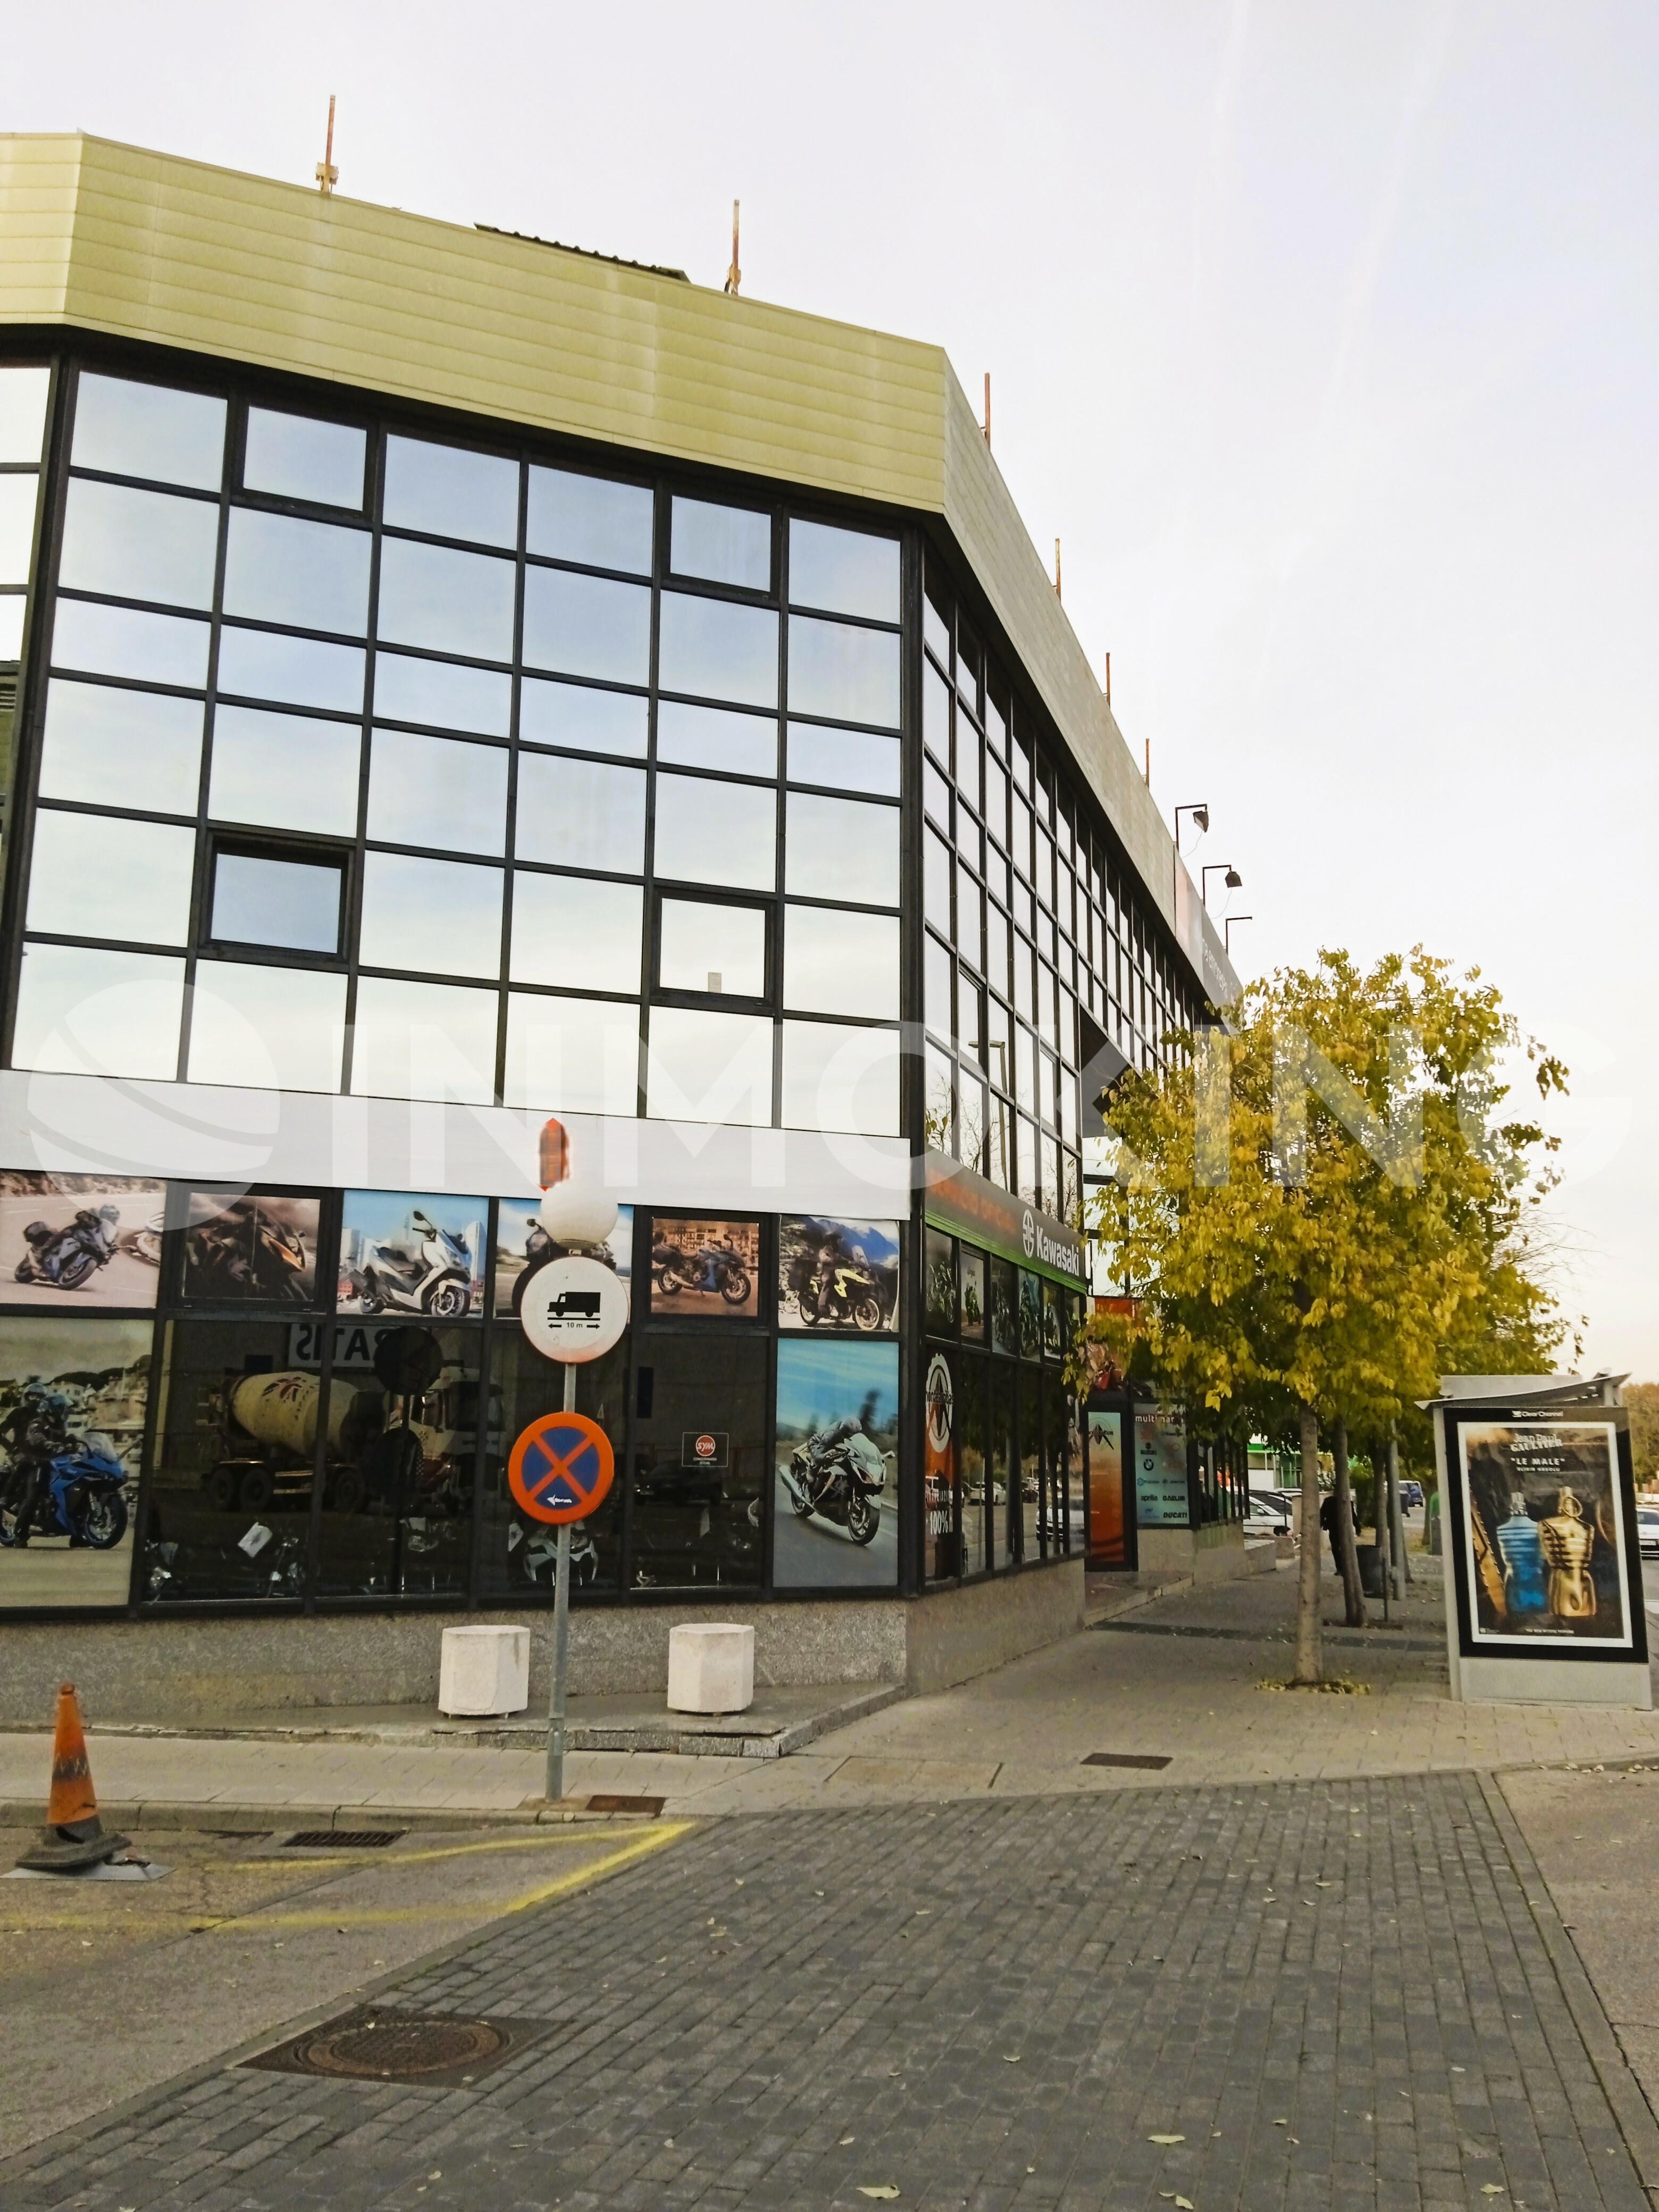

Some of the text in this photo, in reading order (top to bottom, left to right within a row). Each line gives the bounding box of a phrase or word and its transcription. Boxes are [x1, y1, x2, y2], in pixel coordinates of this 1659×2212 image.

[1036, 1225, 1079, 1277] Kawasaki
[697, 1442, 714, 1452] SYM
[1510, 1439, 1563, 1452] GAULTIER
[930, 1510, 948, 1535] 100%
